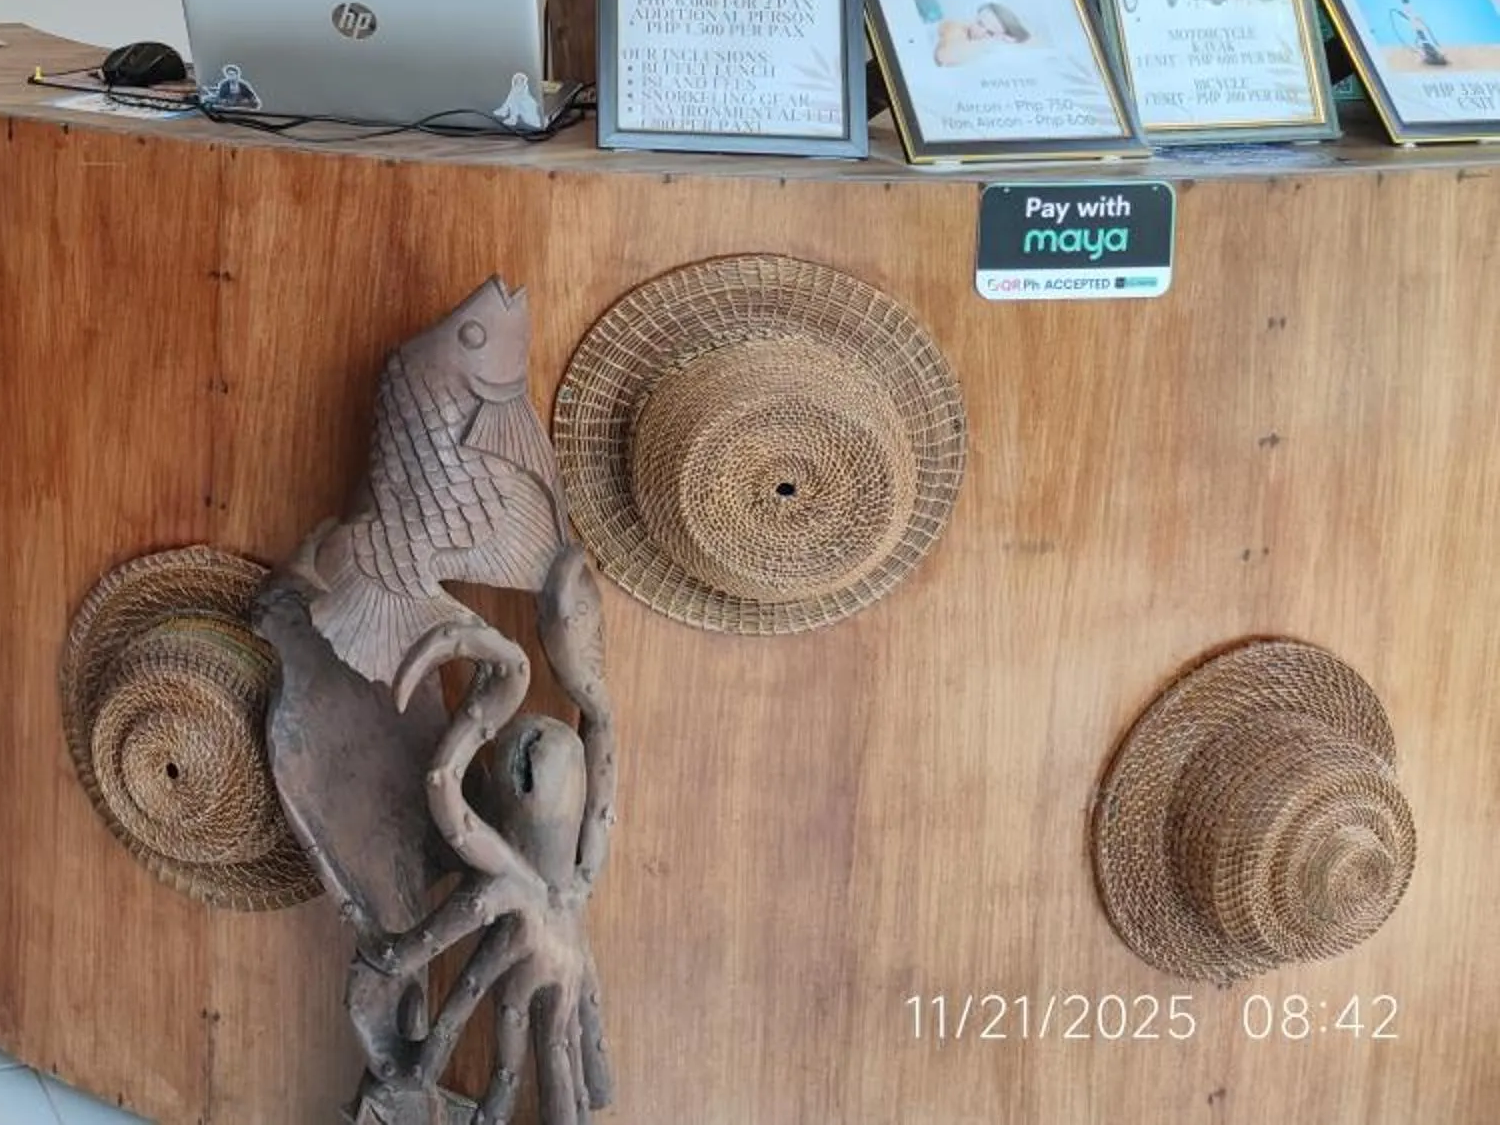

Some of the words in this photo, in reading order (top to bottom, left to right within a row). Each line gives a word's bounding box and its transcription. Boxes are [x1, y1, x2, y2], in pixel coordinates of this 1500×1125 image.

[339, 3, 373, 40] hp
[1025, 196, 1070, 224] Pay
[1077, 194, 1131, 218] with
[1023, 226, 1129, 261] maya
[1044, 278, 1112, 291] ACCEPTED
